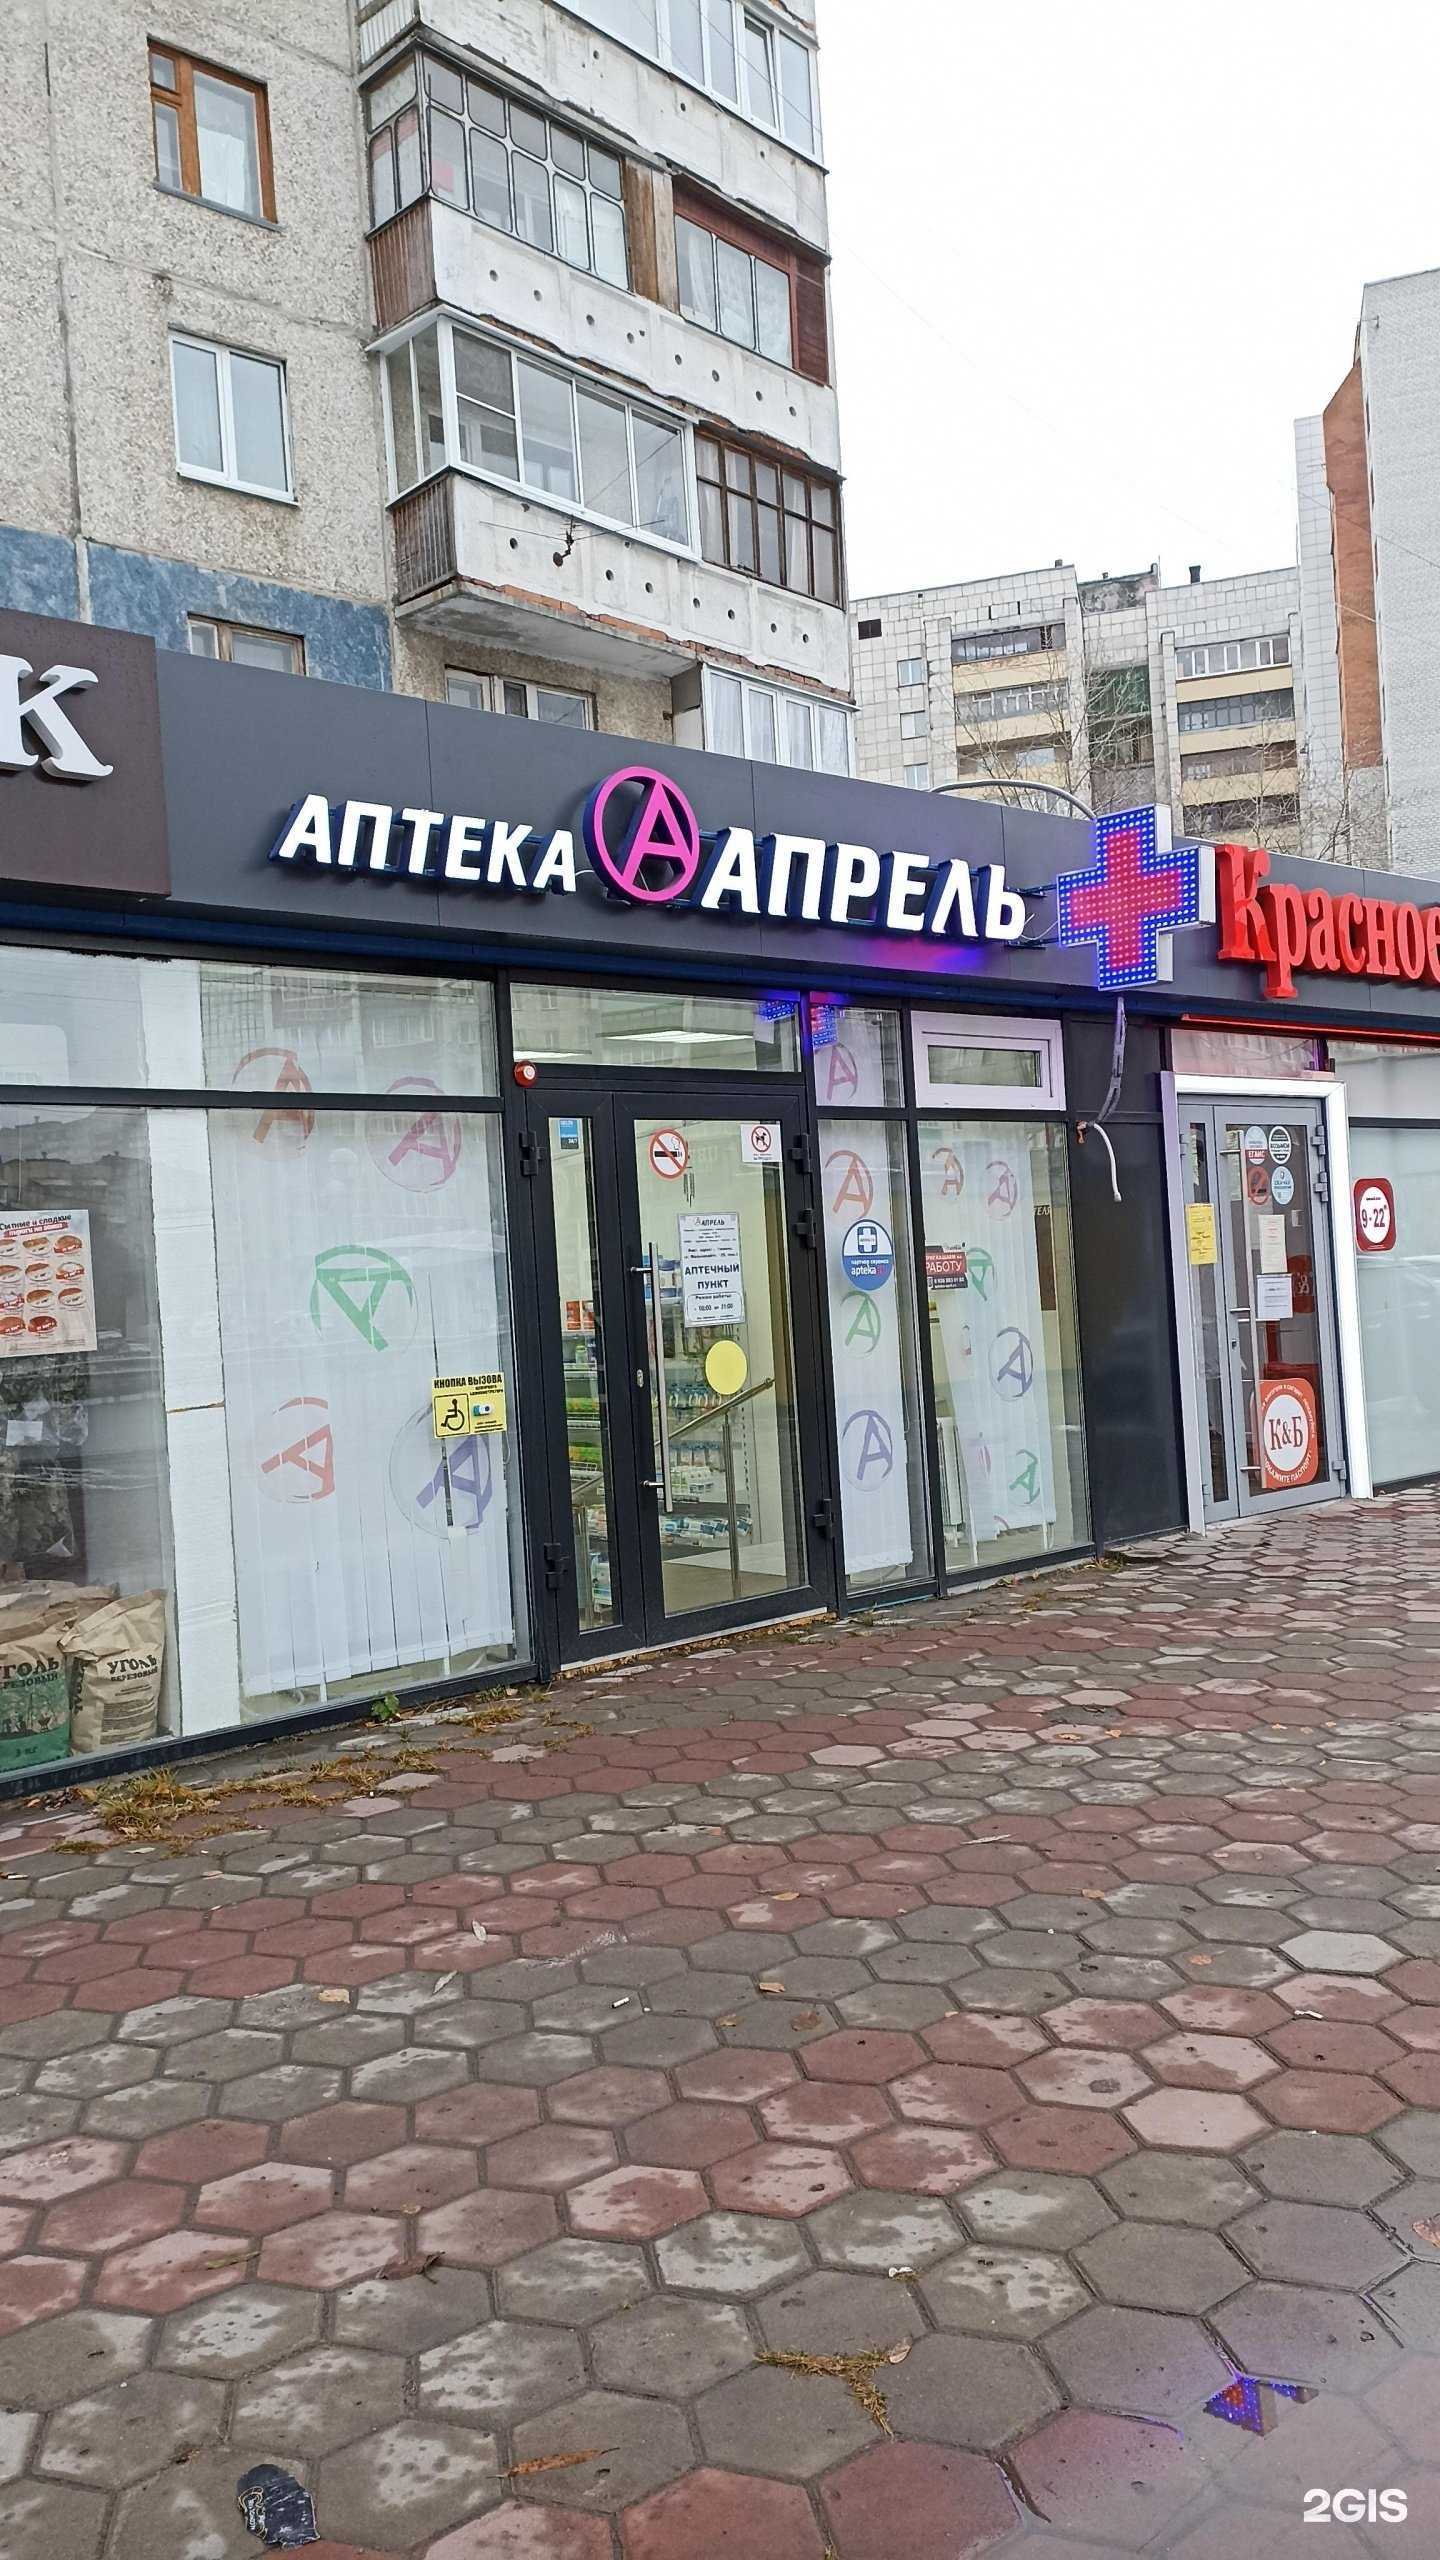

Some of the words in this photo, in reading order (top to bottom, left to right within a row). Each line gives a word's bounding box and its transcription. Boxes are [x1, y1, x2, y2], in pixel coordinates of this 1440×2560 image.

[277, 792, 578, 894] АПТЕКА
[700, 825, 1027, 941] АПРЕЛЬ
[1215, 843, 1440, 998] Красное
[685, 1263, 740, 1275] АПТЕЧНЫЙ
[926, 1260, 963, 1273] РАБОТУ
[697, 1279, 729, 1289] ПУНКТ
[433, 1376, 467, 1389] КНОПКА
[467, 1373, 503, 1386] ВЫЗОВА
[1268, 1415, 1304, 1450] К&Б
[0, 1657, 60, 1679] ГОЛЬ
[107, 1654, 158, 1675] УГОЛЬ
[0, 1673, 58, 1689] РЕЗОВЫЙ
